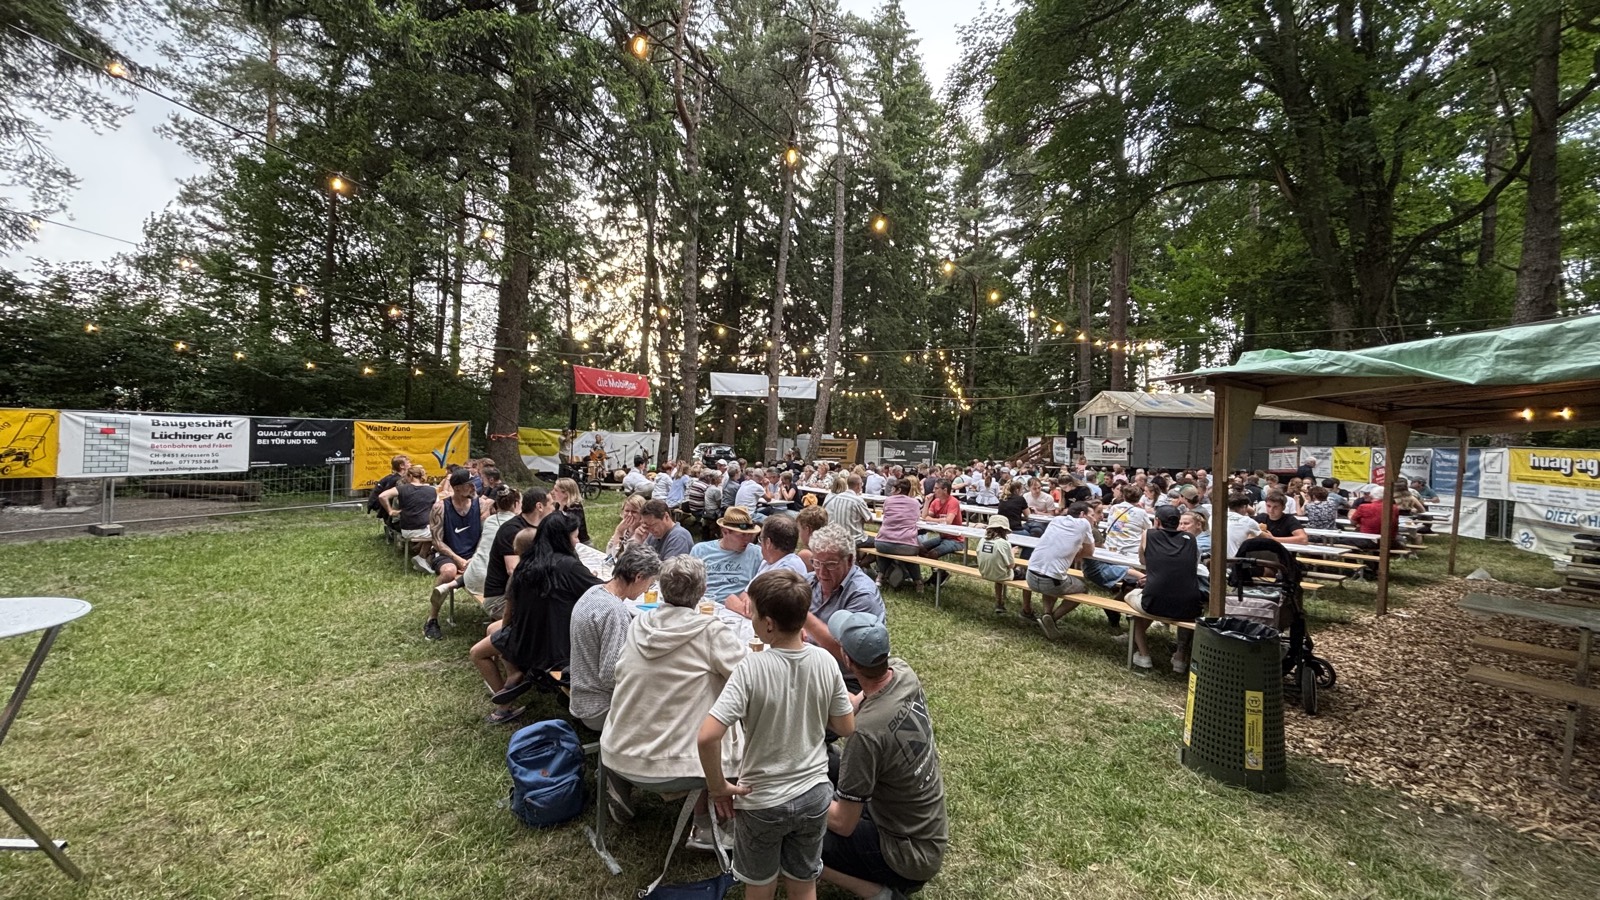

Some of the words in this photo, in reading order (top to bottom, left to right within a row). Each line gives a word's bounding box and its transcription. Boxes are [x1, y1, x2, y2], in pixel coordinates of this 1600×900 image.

[151, 419, 233, 429] Baugeschäft
[151, 431, 213, 441] Lüchinger
[216, 432, 232, 440] AG
[1102, 445, 1126, 453] Hutter
[1530, 453, 1573, 476] huag
[1575, 458, 1600, 478] ag
[888, 695, 912, 733] BKLYN
